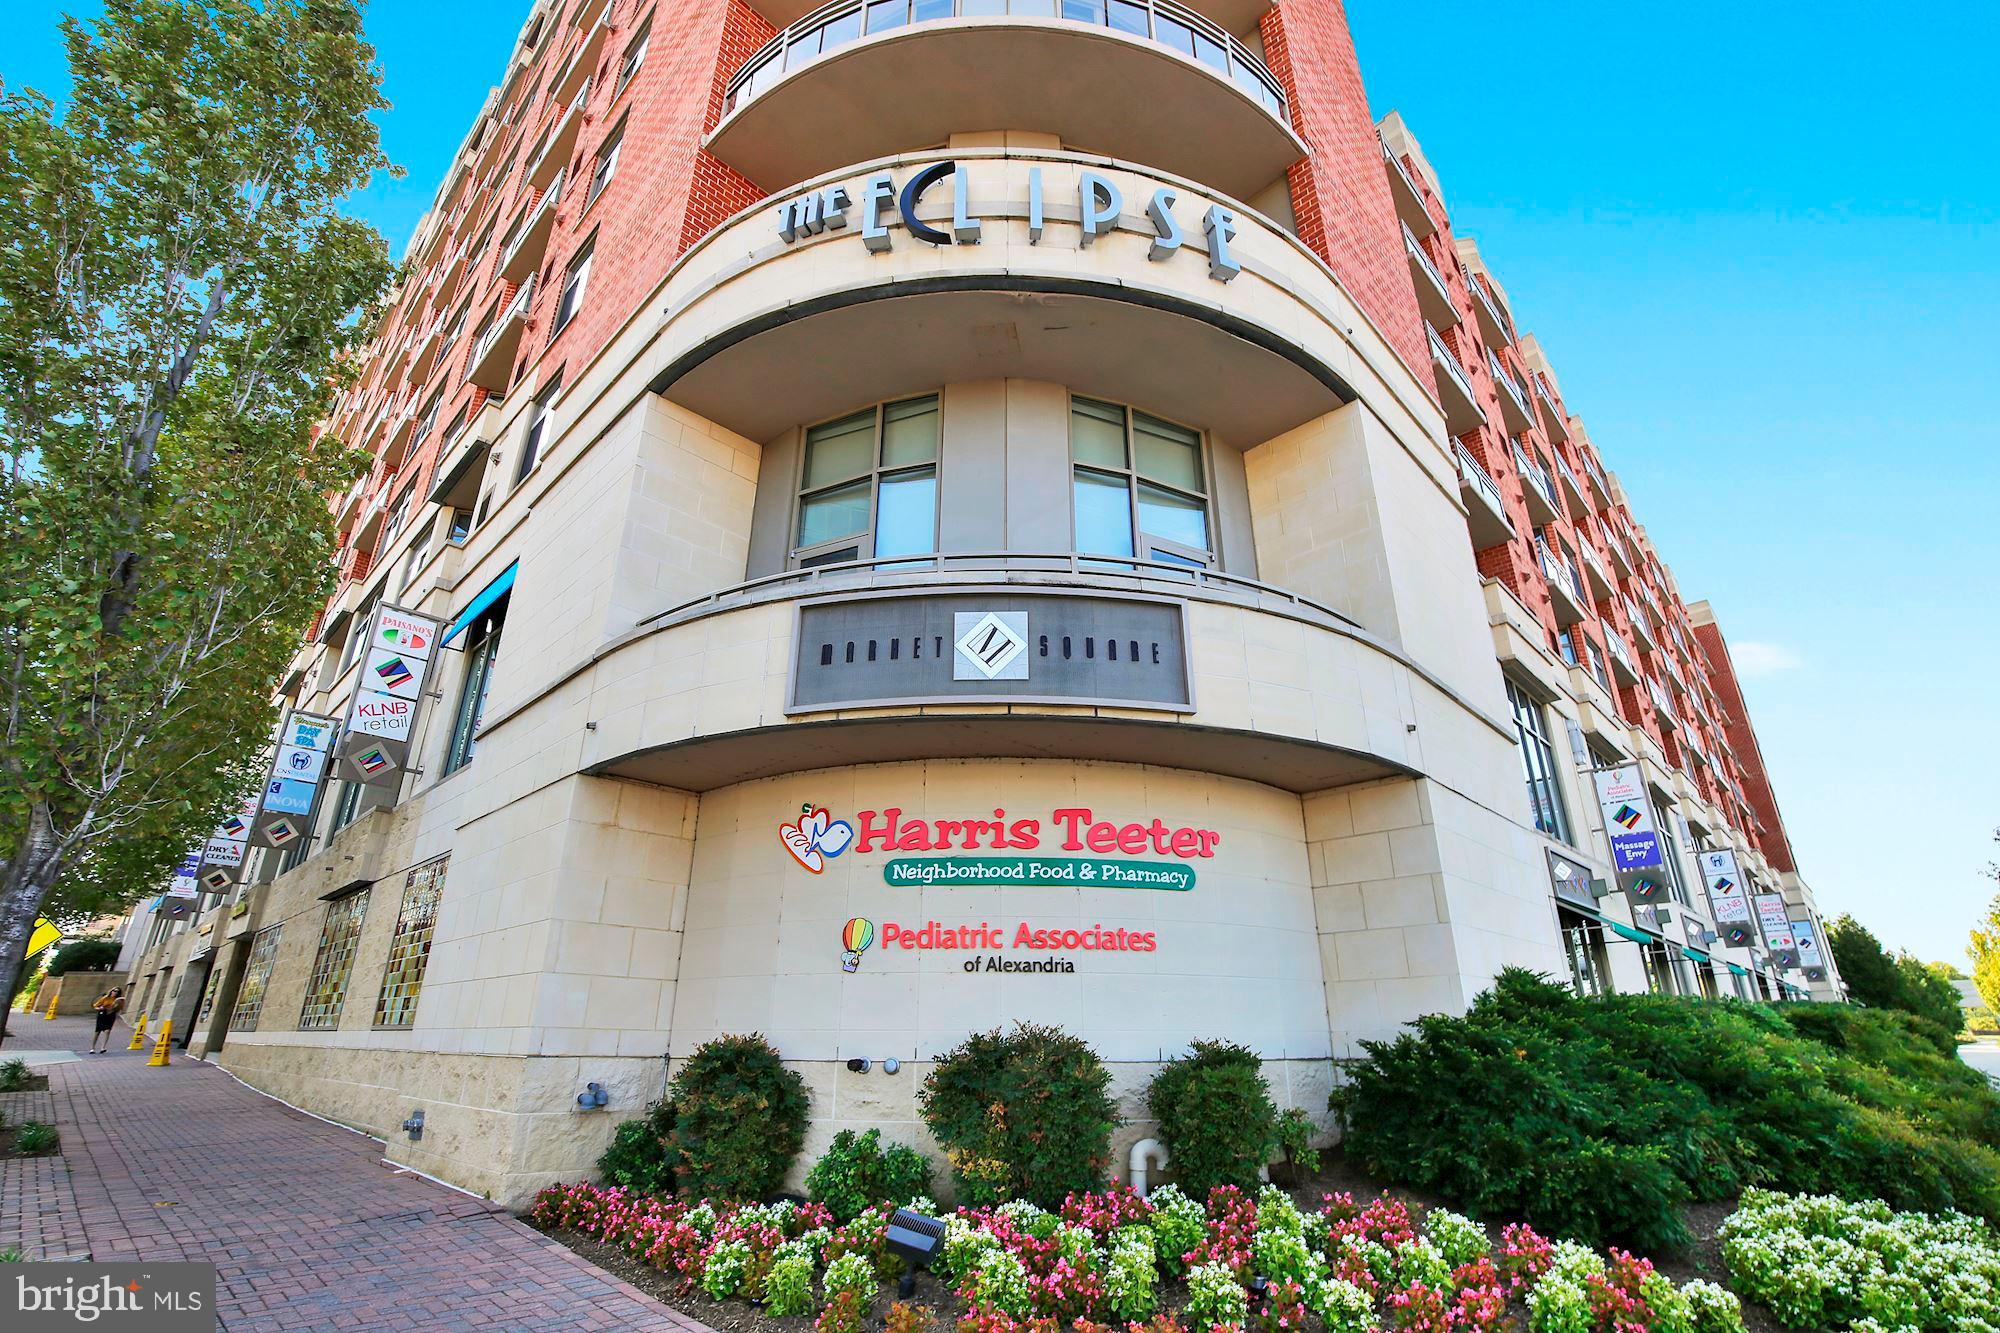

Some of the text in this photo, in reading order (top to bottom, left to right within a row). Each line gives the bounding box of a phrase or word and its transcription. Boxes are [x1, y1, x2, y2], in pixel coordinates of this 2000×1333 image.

[778, 160, 1241, 281] THE ECLIPSE
[381, 616, 433, 638] PAISANO'S
[820, 634, 1160, 666] MARKET SQUARE
[358, 701, 408, 718] KLNB
[363, 715, 408, 732] retail
[855, 807, 1220, 858] Harris Teeter
[208, 845, 229, 854] DRY
[1615, 840, 1654, 851] Massage
[206, 853, 241, 862] CLEANER
[1625, 849, 1647, 861] Envy
[892, 862, 1189, 887] Neighborhood Food & Pharmacy
[881, 920, 1157, 952] Pediatric Associates
[963, 956, 1075, 974] of Alexandria
